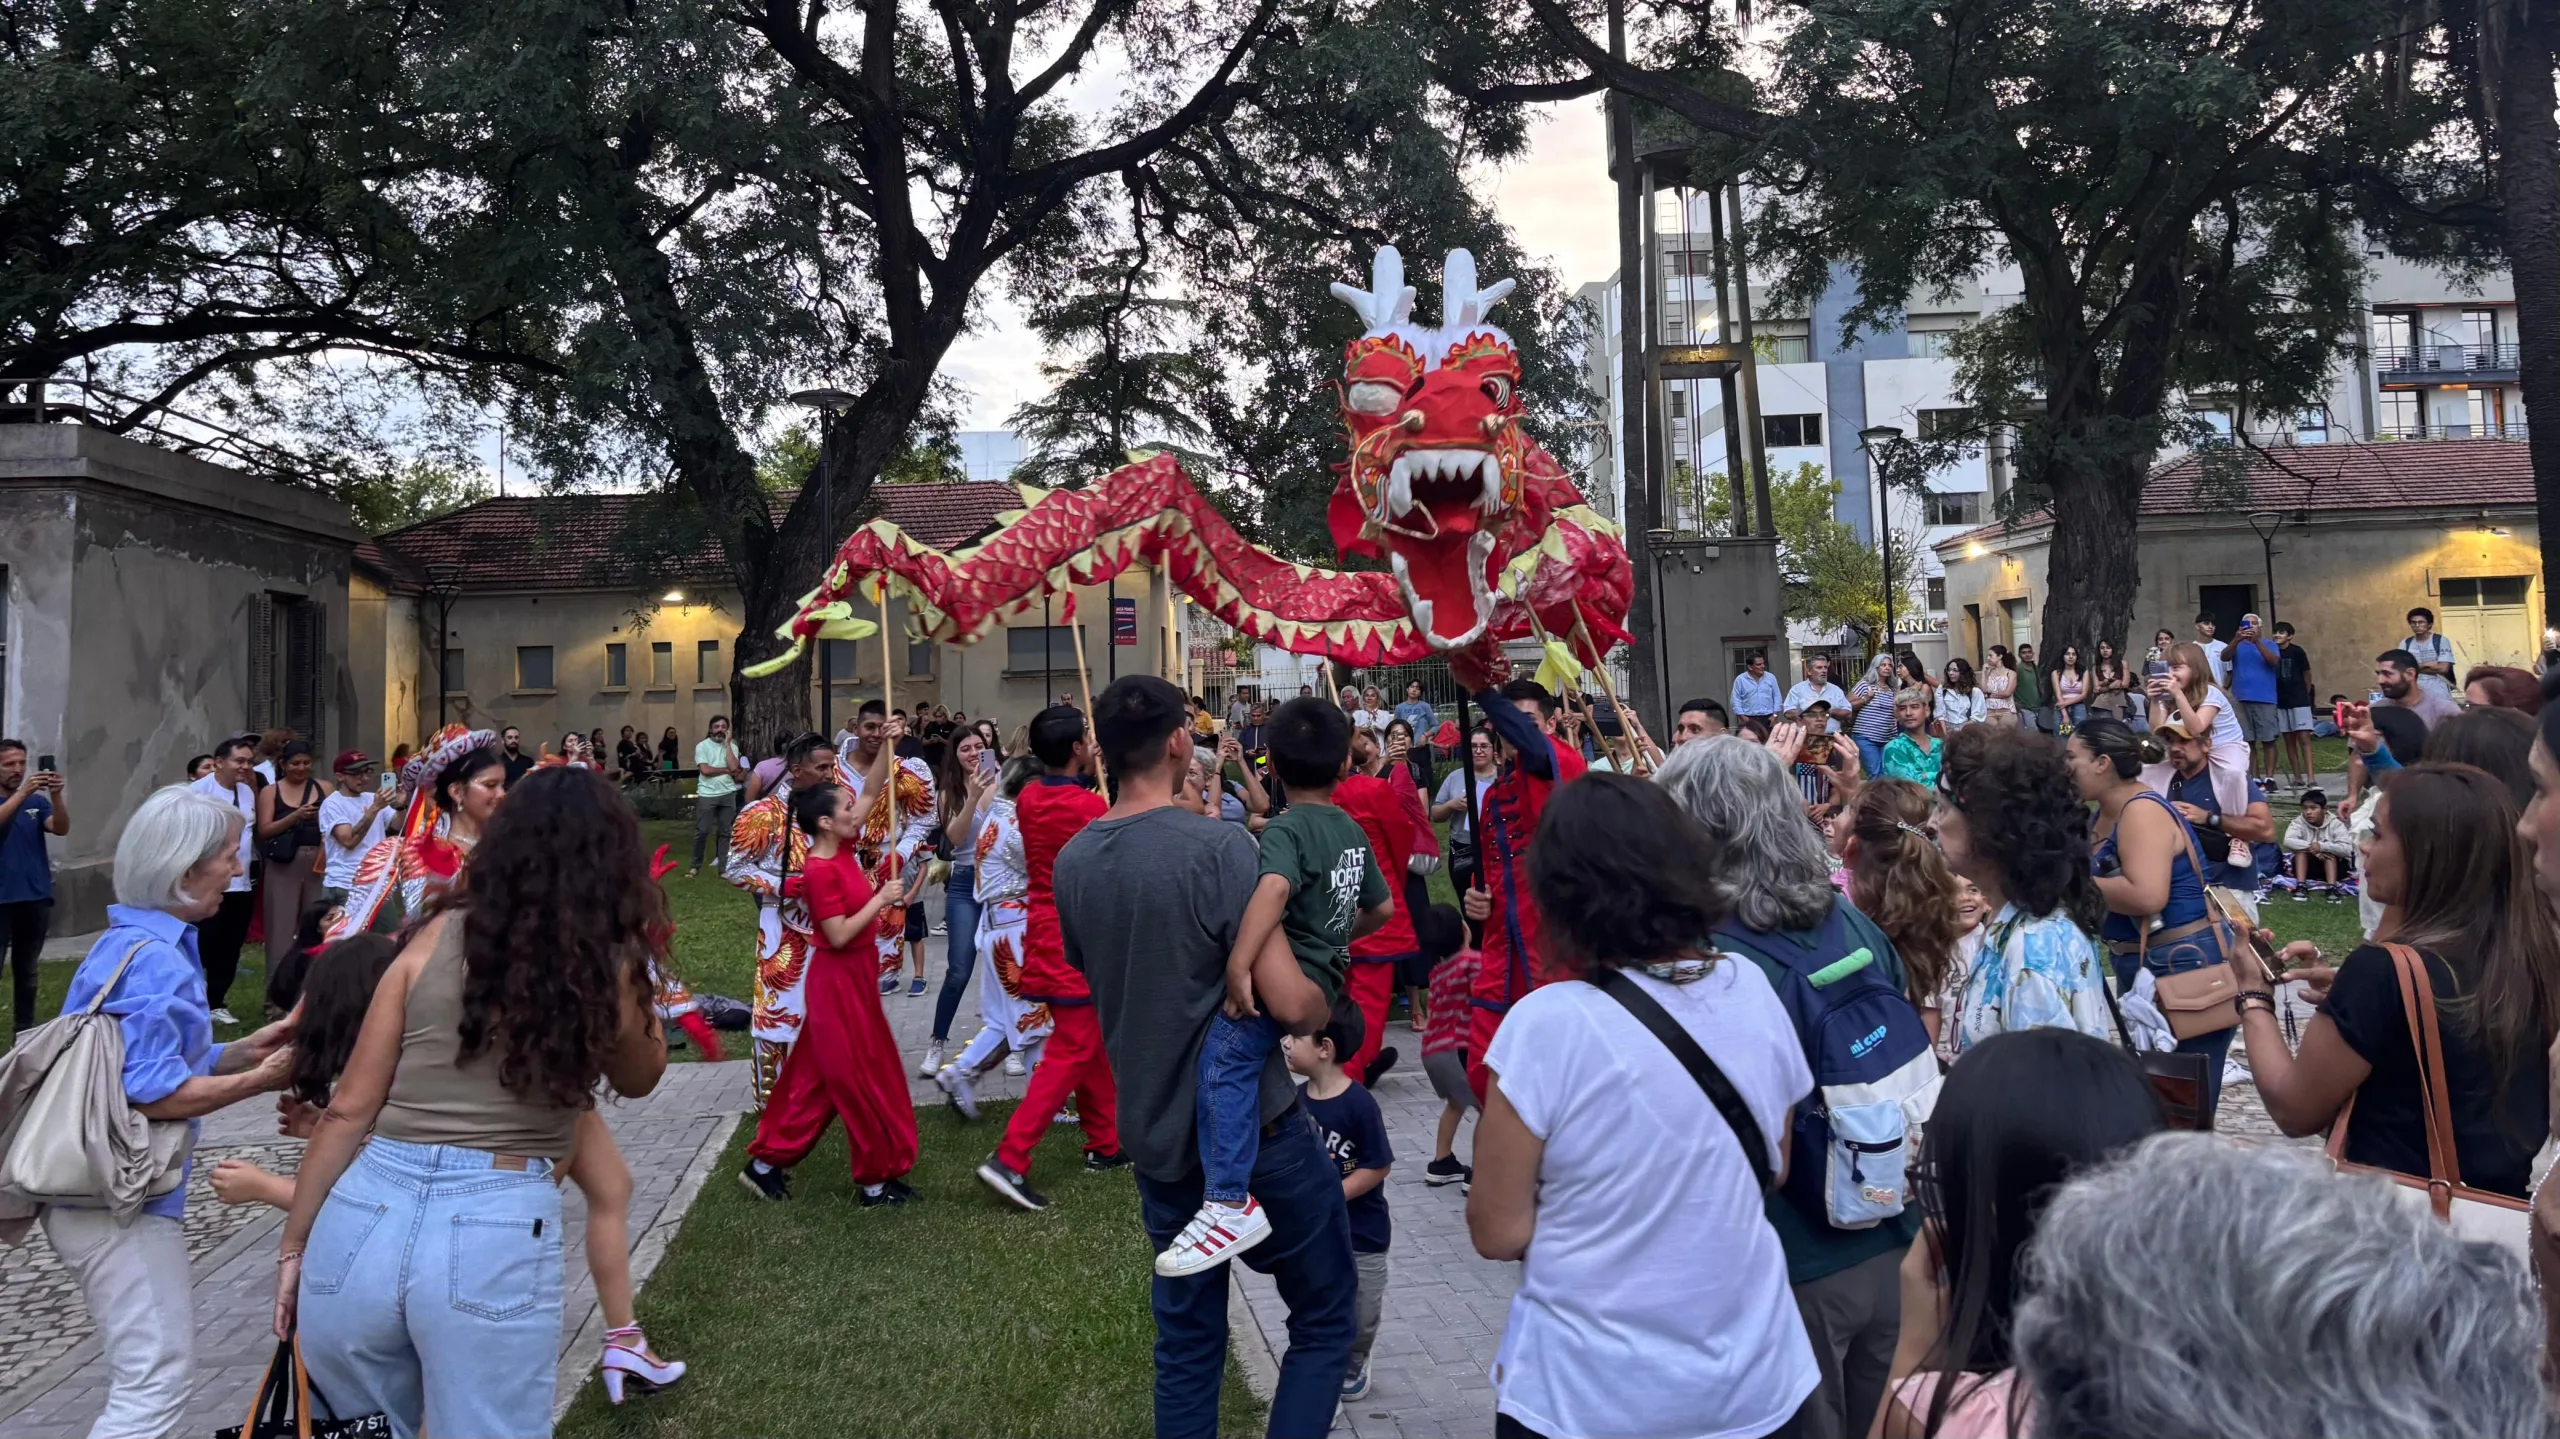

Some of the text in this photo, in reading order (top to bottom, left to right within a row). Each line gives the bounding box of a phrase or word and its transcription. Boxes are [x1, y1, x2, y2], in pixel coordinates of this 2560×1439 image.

[1344, 847, 1366, 867] THE
[1863, 1025, 1887, 1046] cup
[1320, 1126, 1356, 1159] RE
